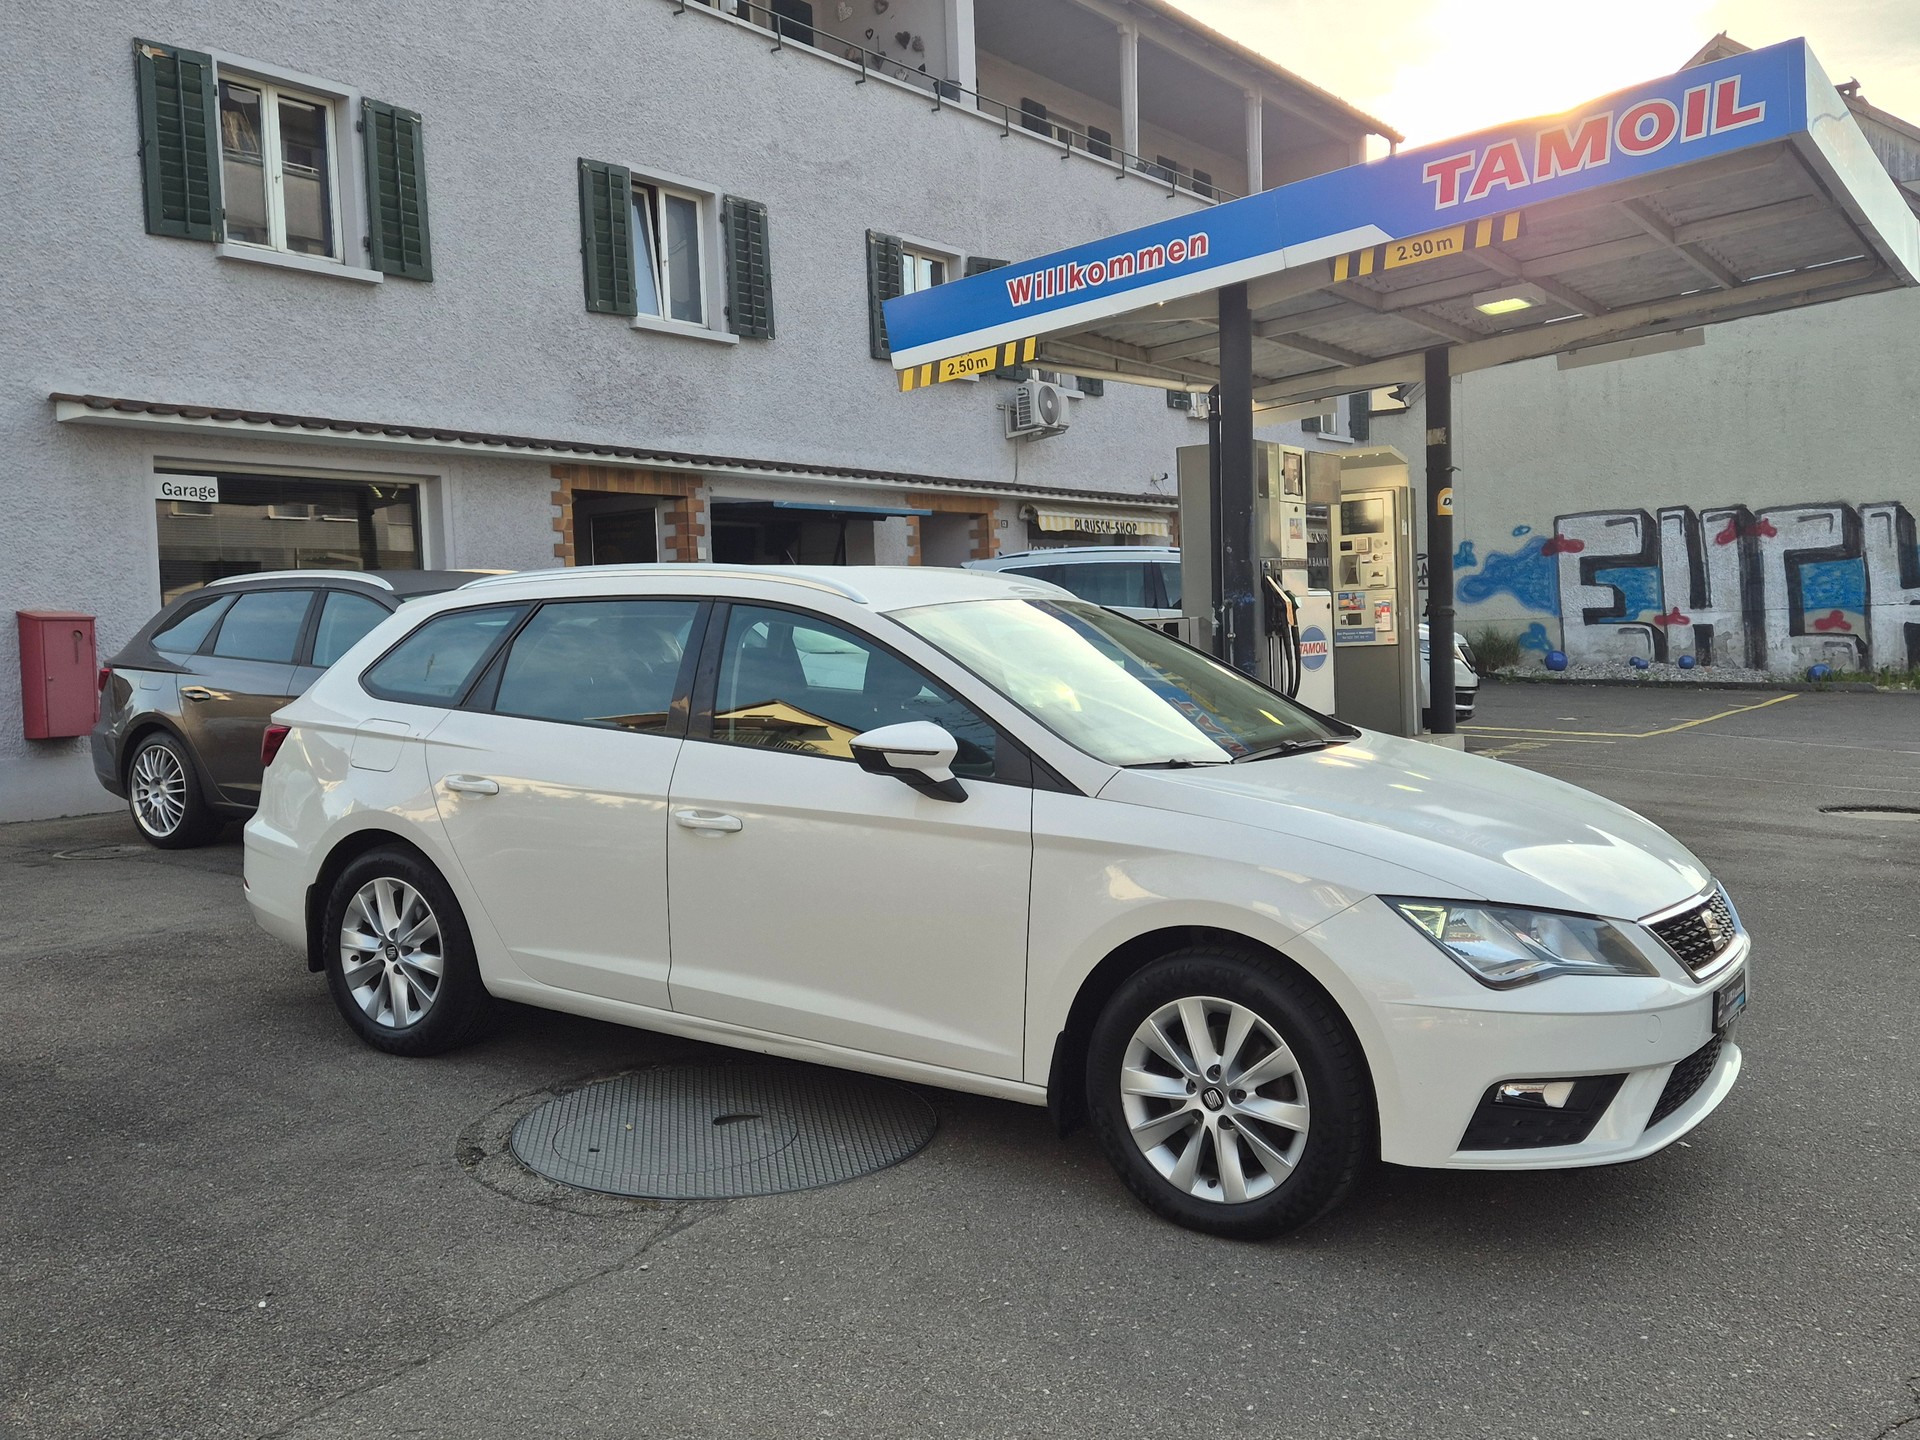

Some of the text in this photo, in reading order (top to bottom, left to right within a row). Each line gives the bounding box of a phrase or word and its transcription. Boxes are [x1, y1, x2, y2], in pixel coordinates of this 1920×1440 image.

[1423, 75, 1765, 210] TAMOIL
[1006, 232, 1208, 306] Willkommen
[162, 482, 216, 501] Garage
[1074, 519, 1138, 535] PLAUSCH-SHOP
[1299, 642, 1328, 655] TAMOIL
